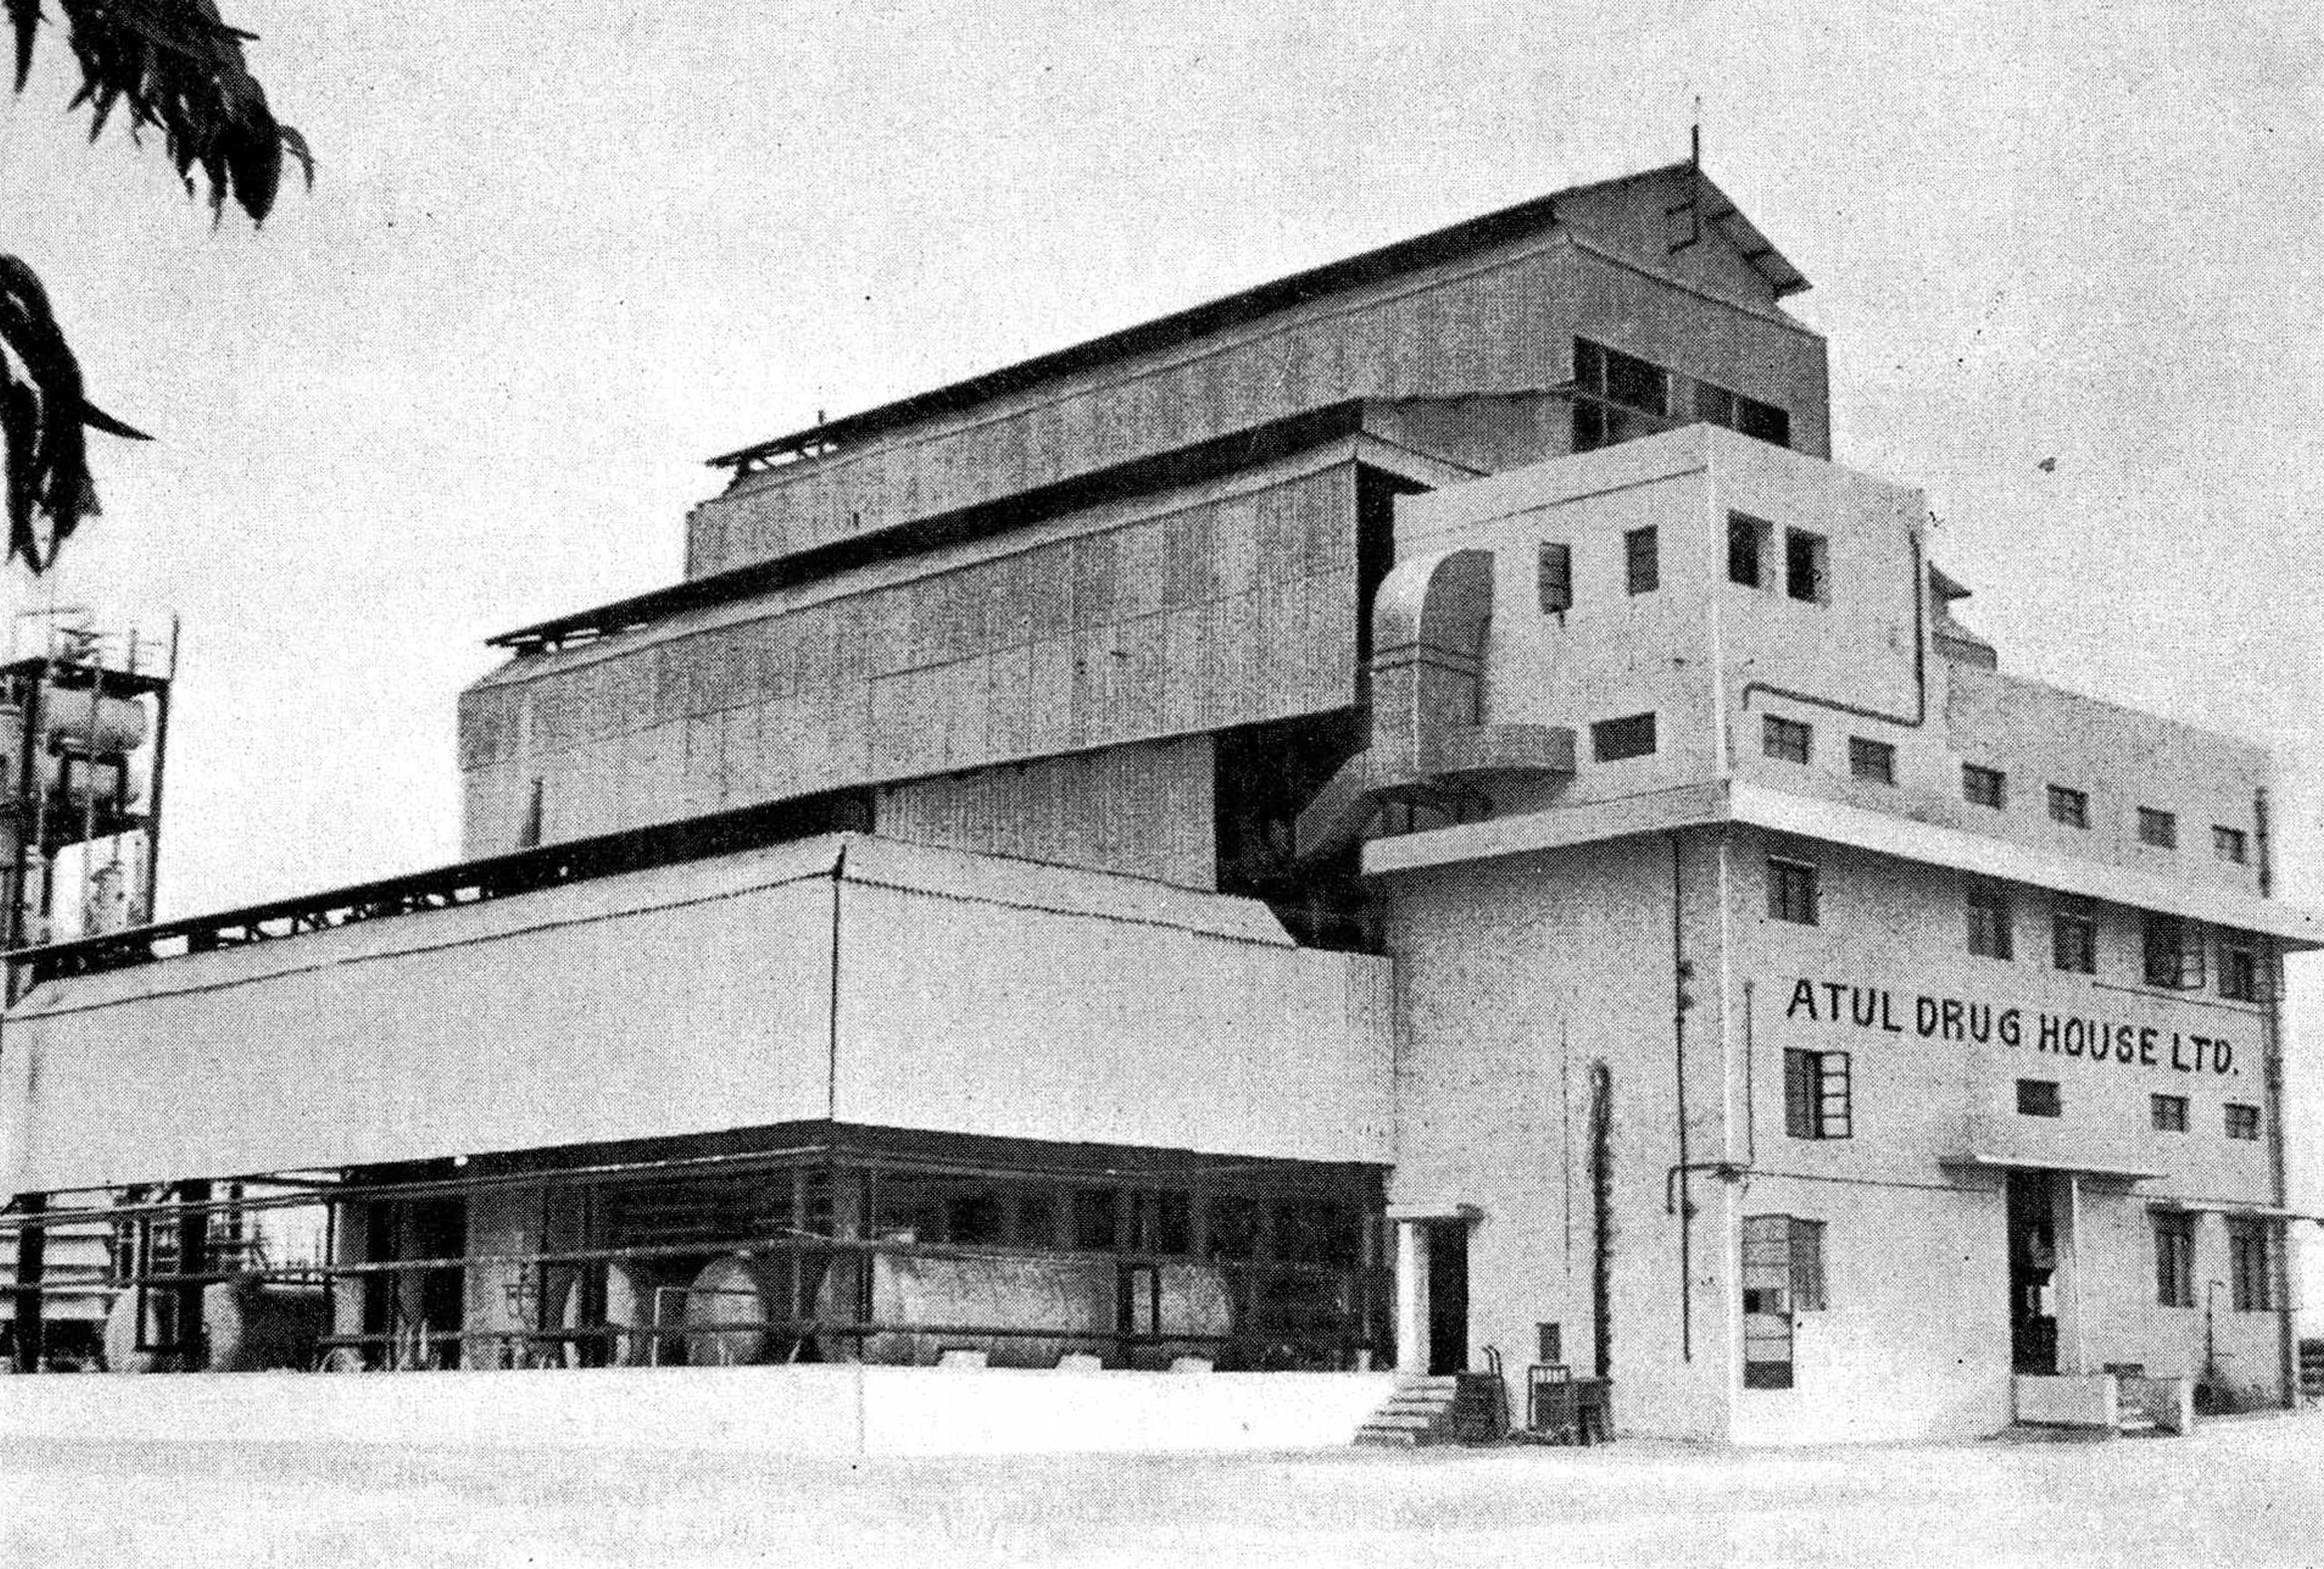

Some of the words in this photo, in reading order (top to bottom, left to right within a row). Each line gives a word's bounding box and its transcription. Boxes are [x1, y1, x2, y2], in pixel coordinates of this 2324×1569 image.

[1786, 979, 1902, 1032] ATUL
[1916, 996, 2020, 1046] DRUG
[2039, 1013, 2159, 1065] HOUSE
[2171, 1033, 2239, 1075] LTD.
